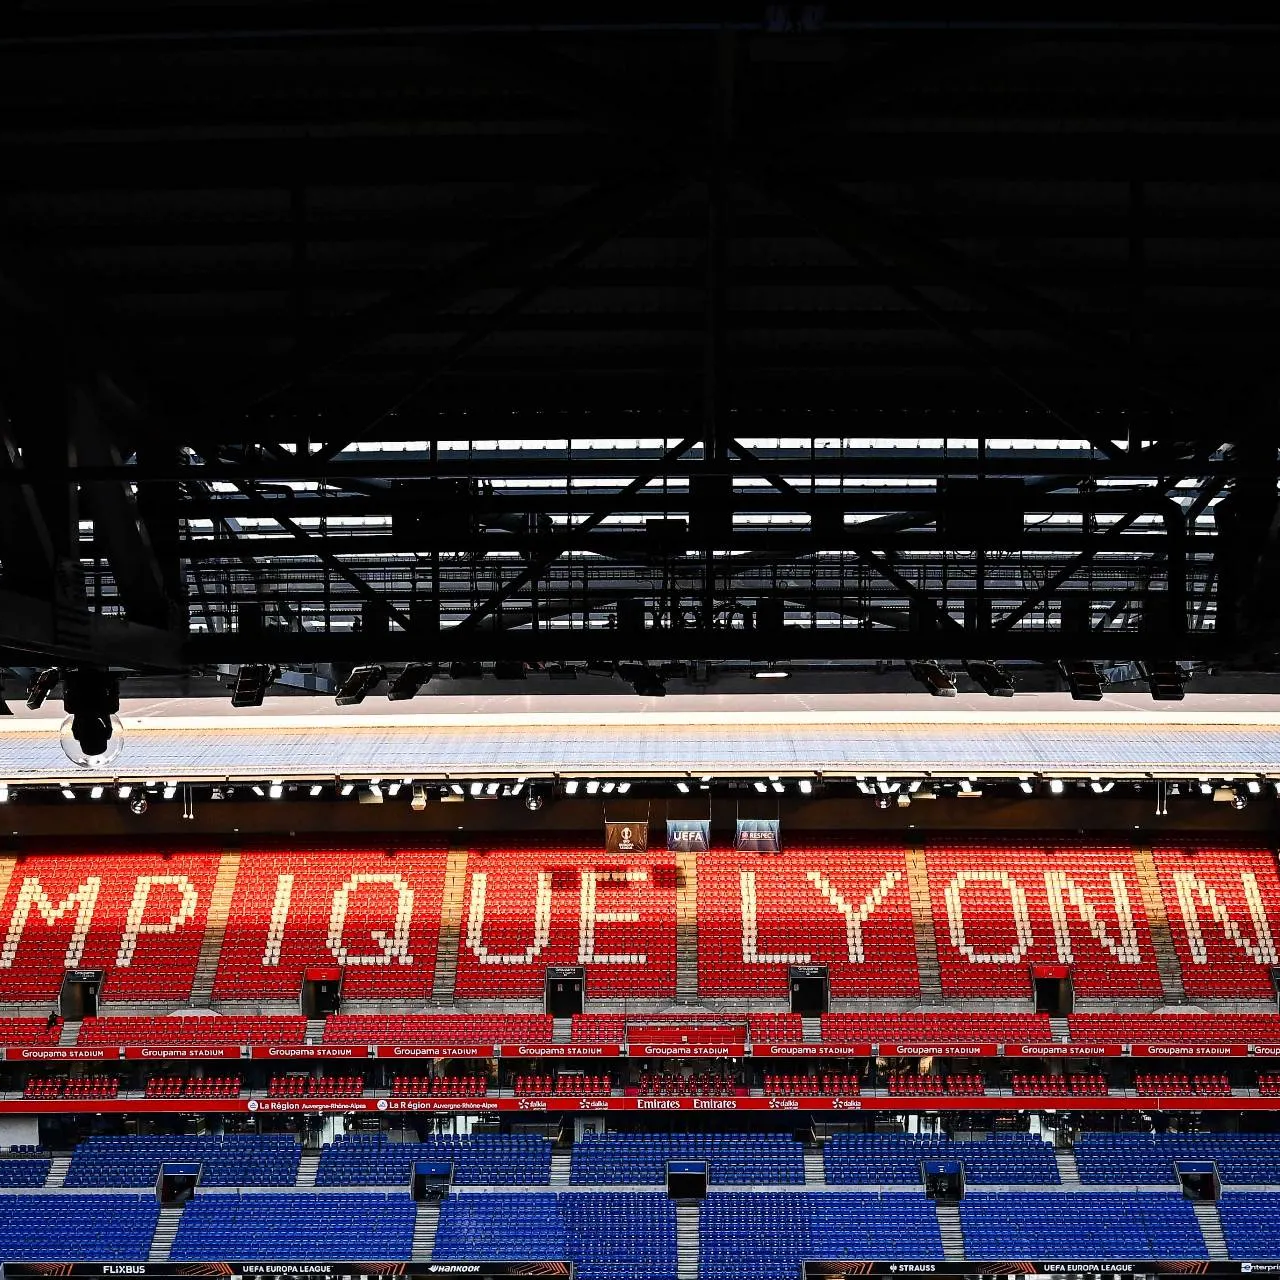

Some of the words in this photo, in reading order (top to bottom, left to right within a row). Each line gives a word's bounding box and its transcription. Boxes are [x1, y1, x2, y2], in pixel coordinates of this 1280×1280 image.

[673, 831, 703, 841] UEFA
[750, 832, 774, 840] RESPECT
[22, 1048, 67, 1060] Groupama
[69, 1050, 104, 1058] STADIUM
[141, 1047, 187, 1058] Groupama
[189, 1049, 224, 1057] STADIUM
[268, 1047, 315, 1058] Groupama
[316, 1048, 352, 1056] STADIUM
[394, 1046, 440, 1057] Groupama
[442, 1048, 478, 1056] STADIUM
[518, 1046, 565, 1057] Groupama
[567, 1047, 602, 1055] STADIUM
[644, 1045, 691, 1056] Groupama
[693, 1047, 729, 1055] STADIUM
[770, 1045, 817, 1056] Groupama
[819, 1047, 854, 1055] STADIUM
[896, 1045, 943, 1056] Groupama
[945, 1047, 981, 1055] STADIUM
[1021, 1045, 1068, 1056] Groupama
[1070, 1047, 1105, 1055] STADIUM
[1147, 1045, 1194, 1056] Groupama
[1196, 1047, 1231, 1055] STADIUM
[259, 1101, 269, 1110] La
[271, 1100, 300, 1111] Région
[389, 1101, 399, 1109] La
[400, 1100, 431, 1111] Région
[637, 1099, 680, 1109] Emirates
[693, 1099, 737, 1109] Emirates
[242, 1265, 264, 1273] UEFA
[266, 1265, 297, 1273] EUROPA
[299, 1265, 330, 1273] LEAGUE
[899, 1264, 935, 1272] STRAUSS
[1044, 1264, 1064, 1272] UEFA
[1067, 1264, 1097, 1272] EUROPA
[1100, 1264, 1132, 1272] LEAGUE
